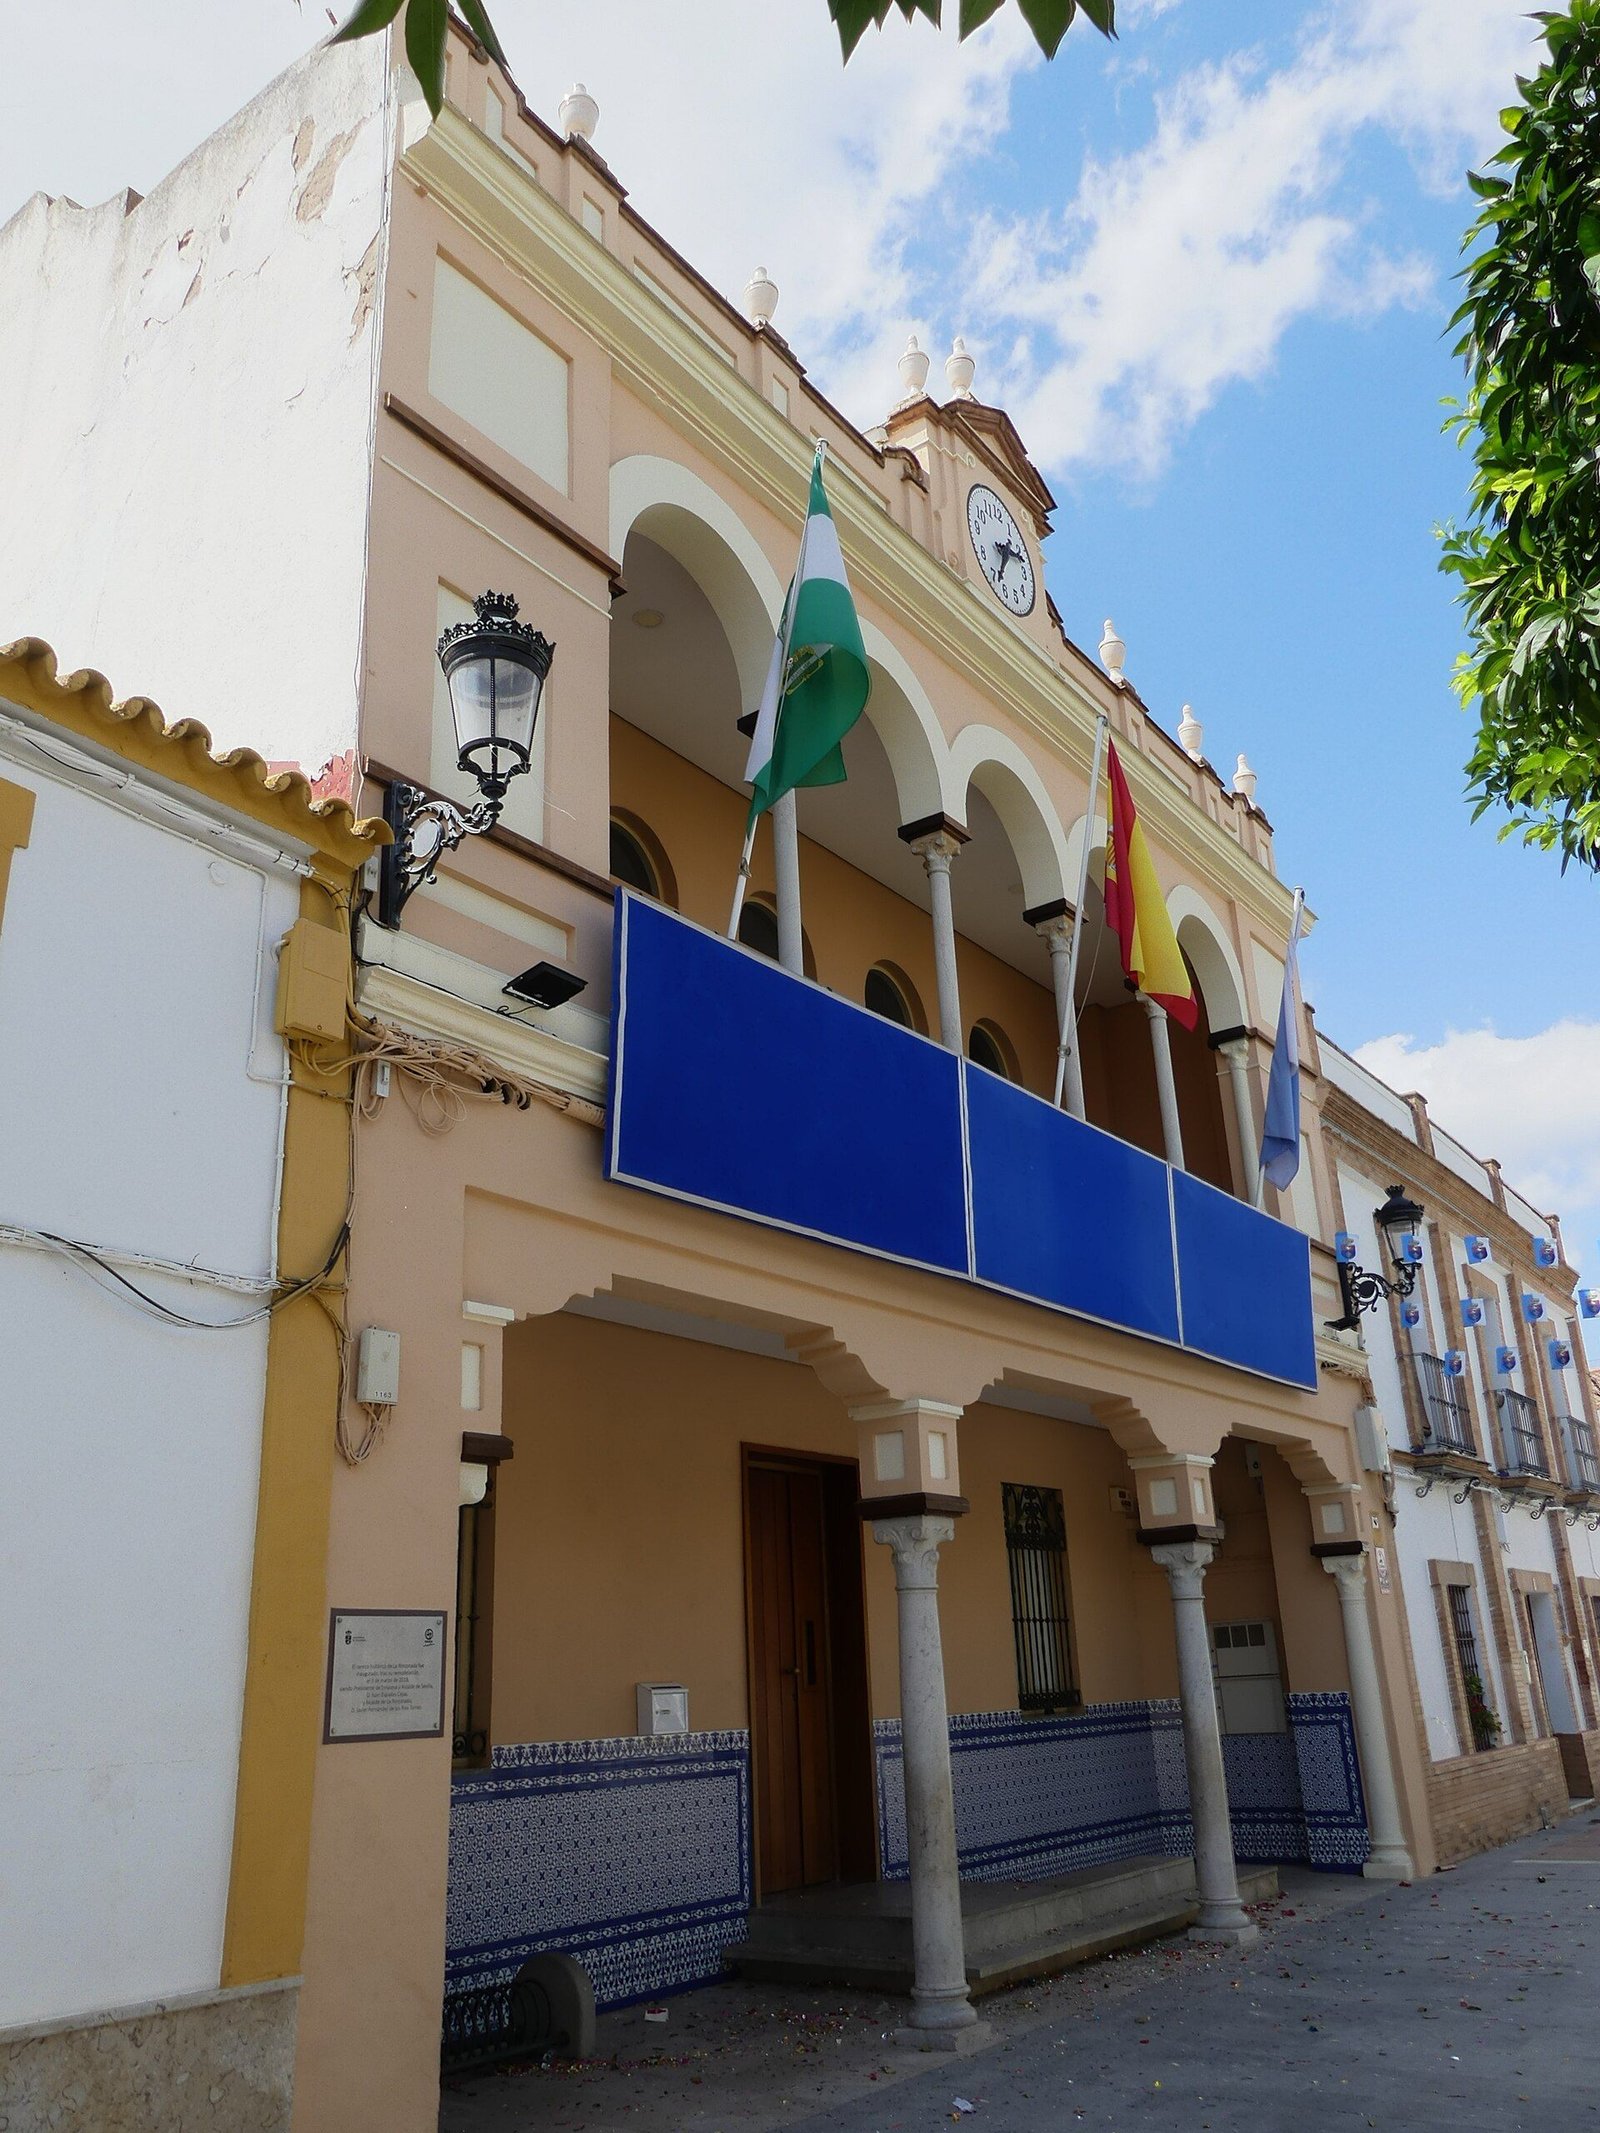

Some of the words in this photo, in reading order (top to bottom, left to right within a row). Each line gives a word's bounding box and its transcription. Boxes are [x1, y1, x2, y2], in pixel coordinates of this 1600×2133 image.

[975, 505, 986, 525] 10
[983, 499, 993, 520] 11
[992, 504, 1003, 523] 12
[974, 520, 981, 535] 9
[1006, 523, 1012, 538] 1
[980, 545, 987, 561] 8
[990, 567, 997, 582] 7
[1021, 566, 1028, 581] 3
[1002, 584, 1009, 599] 6
[1012, 589, 1019, 604] 5
[1020, 584, 1026, 598] 4
